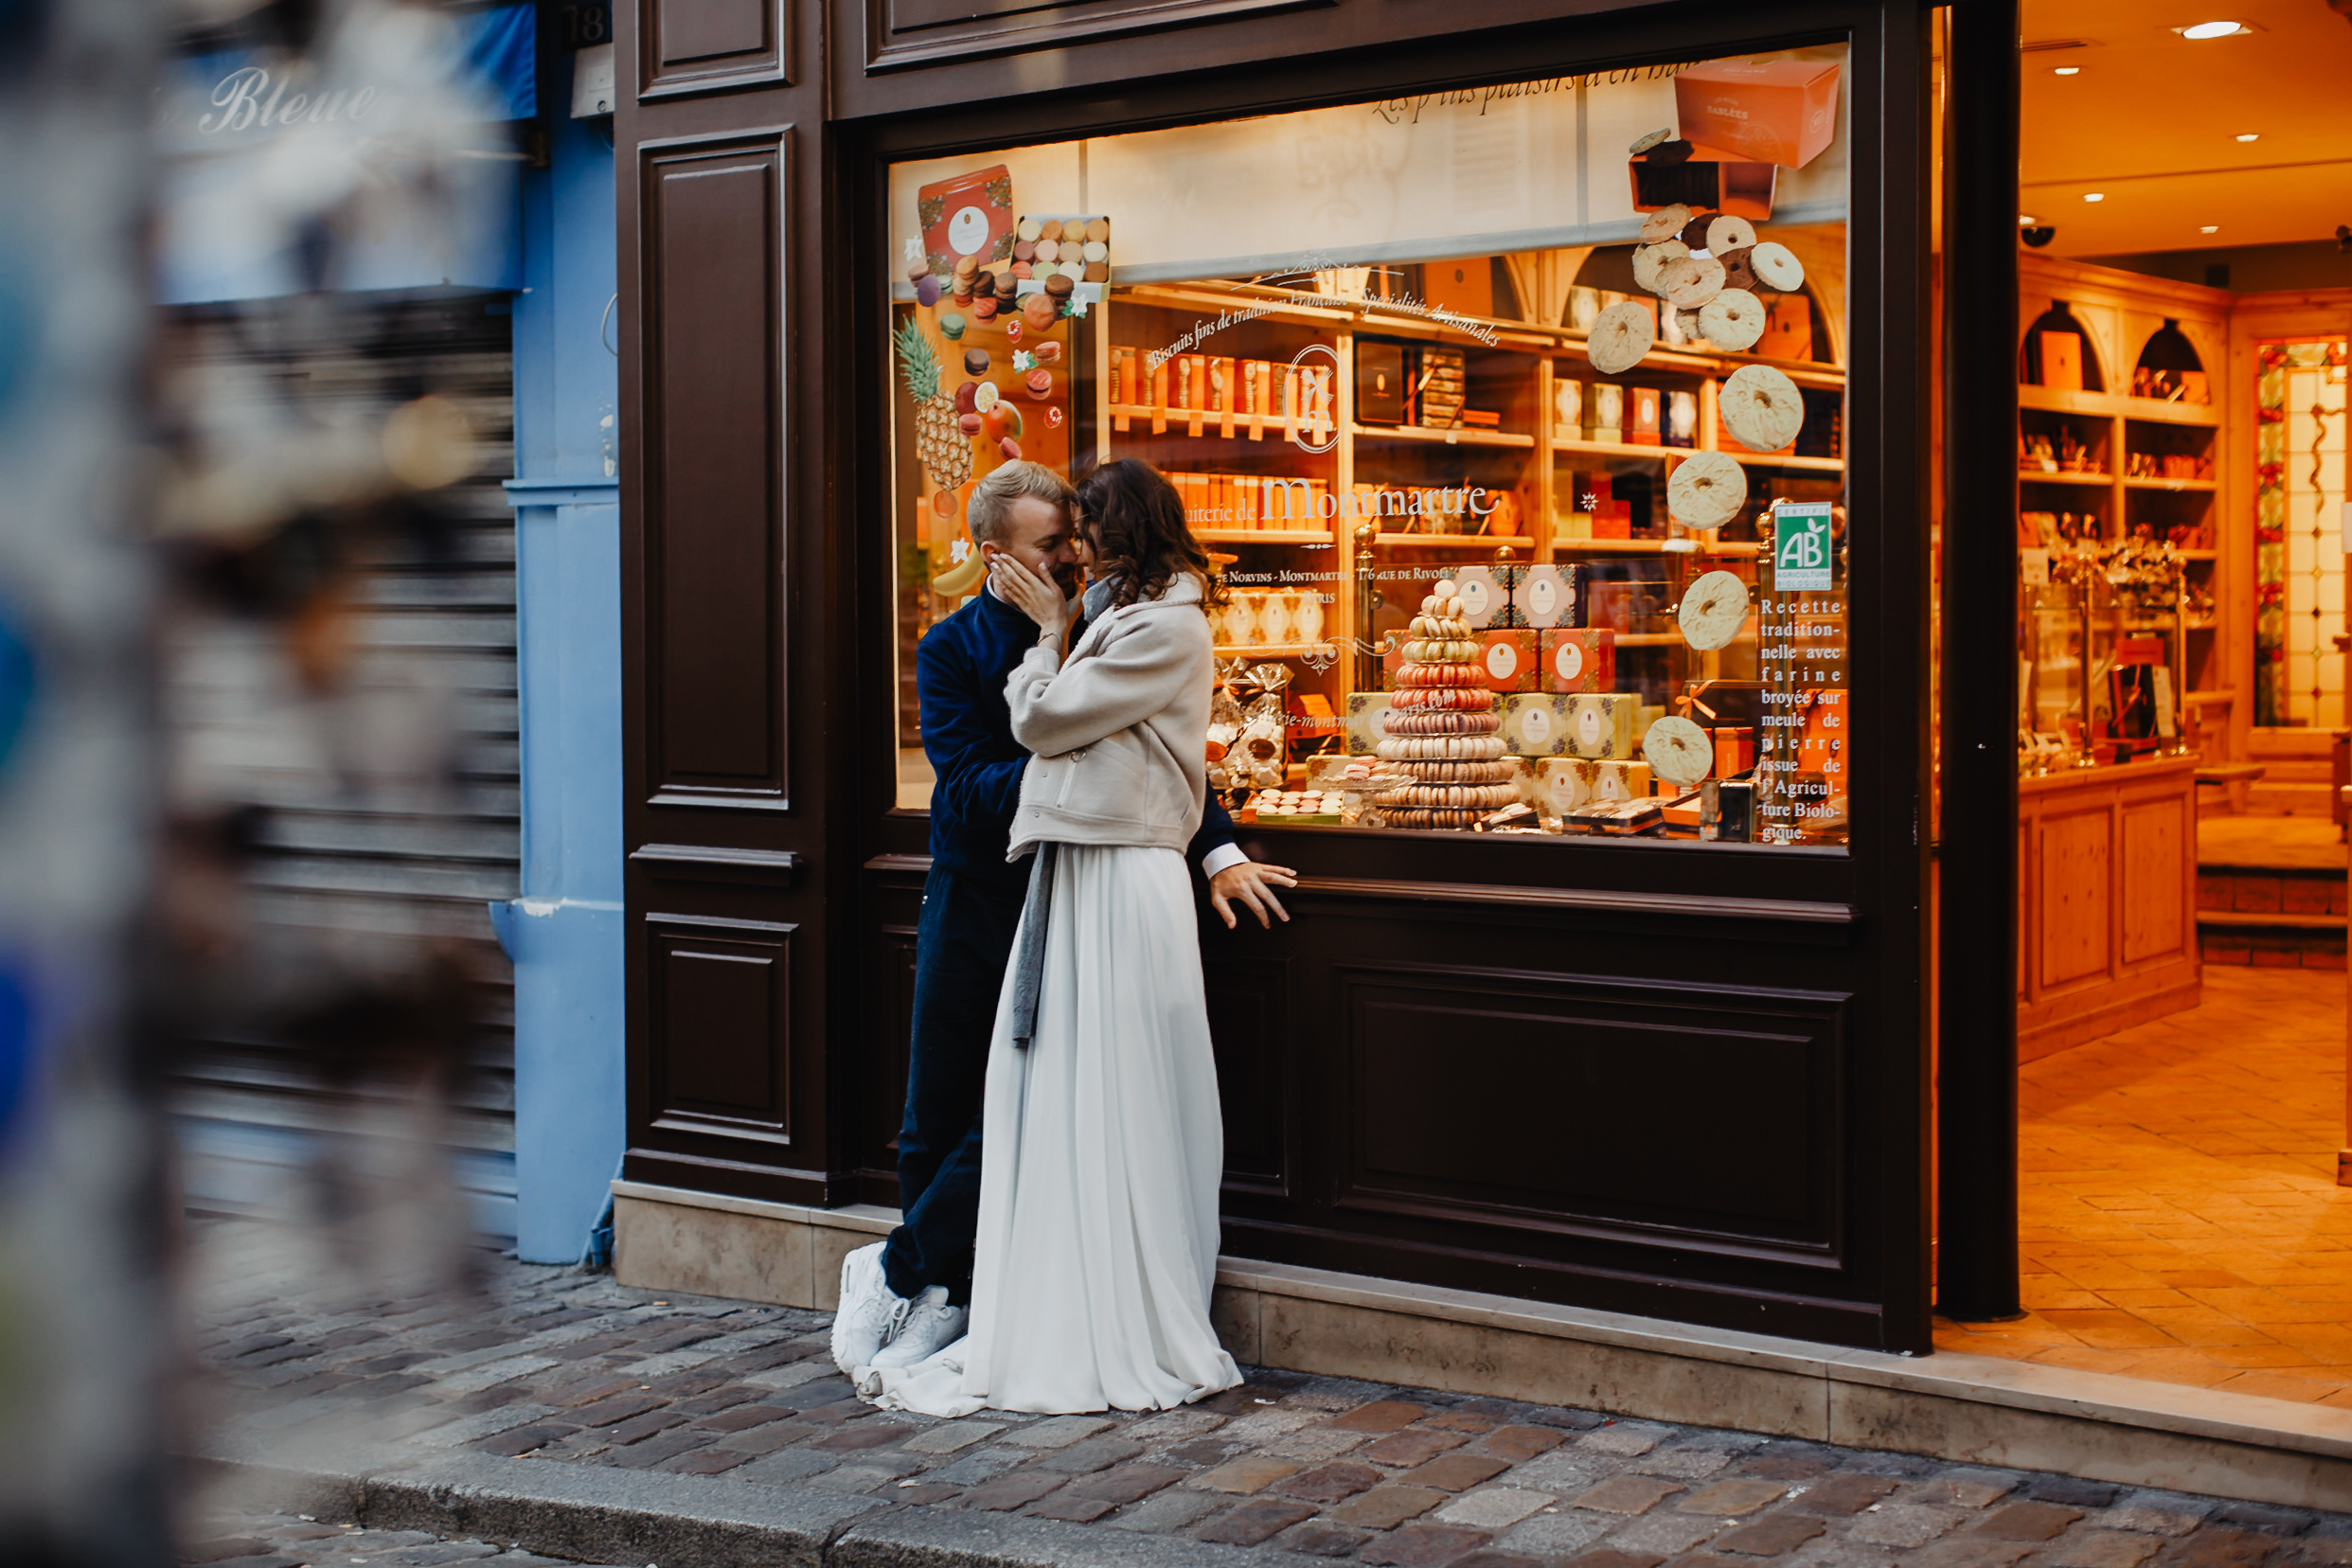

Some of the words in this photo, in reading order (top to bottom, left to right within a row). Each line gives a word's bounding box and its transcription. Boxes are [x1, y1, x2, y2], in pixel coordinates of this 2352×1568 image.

[562, 5, 604, 42] 18
[198, 66, 386, 134] Bleue
[1148, 332, 1194, 369] Biscuits
[1194, 320, 1216, 350] fins
[1217, 309, 1231, 331] de
[1233, 296, 1288, 325] tradition
[1359, 287, 1428, 316] Spécialités
[1426, 302, 1501, 347] Artisanales
[1184, 504, 1233, 523] uiterie
[1236, 497, 1256, 521] de
[1260, 477, 1501, 520] Montmartre
[1779, 531, 1823, 568] AB
[1776, 570, 1830, 579] AGRICULTURE
[1761, 599, 1841, 615] Recette
[1760, 621, 1841, 636] tradition-
[1761, 644, 1797, 659] nelle
[1806, 648, 1841, 659] avec
[1761, 666, 1841, 682] farine
[1761, 689, 1810, 708] broyée
[1817, 693, 1841, 704] sur
[1761, 712, 1806, 727] meule
[1822, 712, 1841, 727] de
[1761, 734, 1841, 753] pierre
[1762, 757, 1798, 772] issue
[1823, 757, 1841, 773] de
[1762, 803, 1791, 817] ture
[1794, 802, 1841, 818] Biolo-
[1762, 827, 1807, 842] gique.
